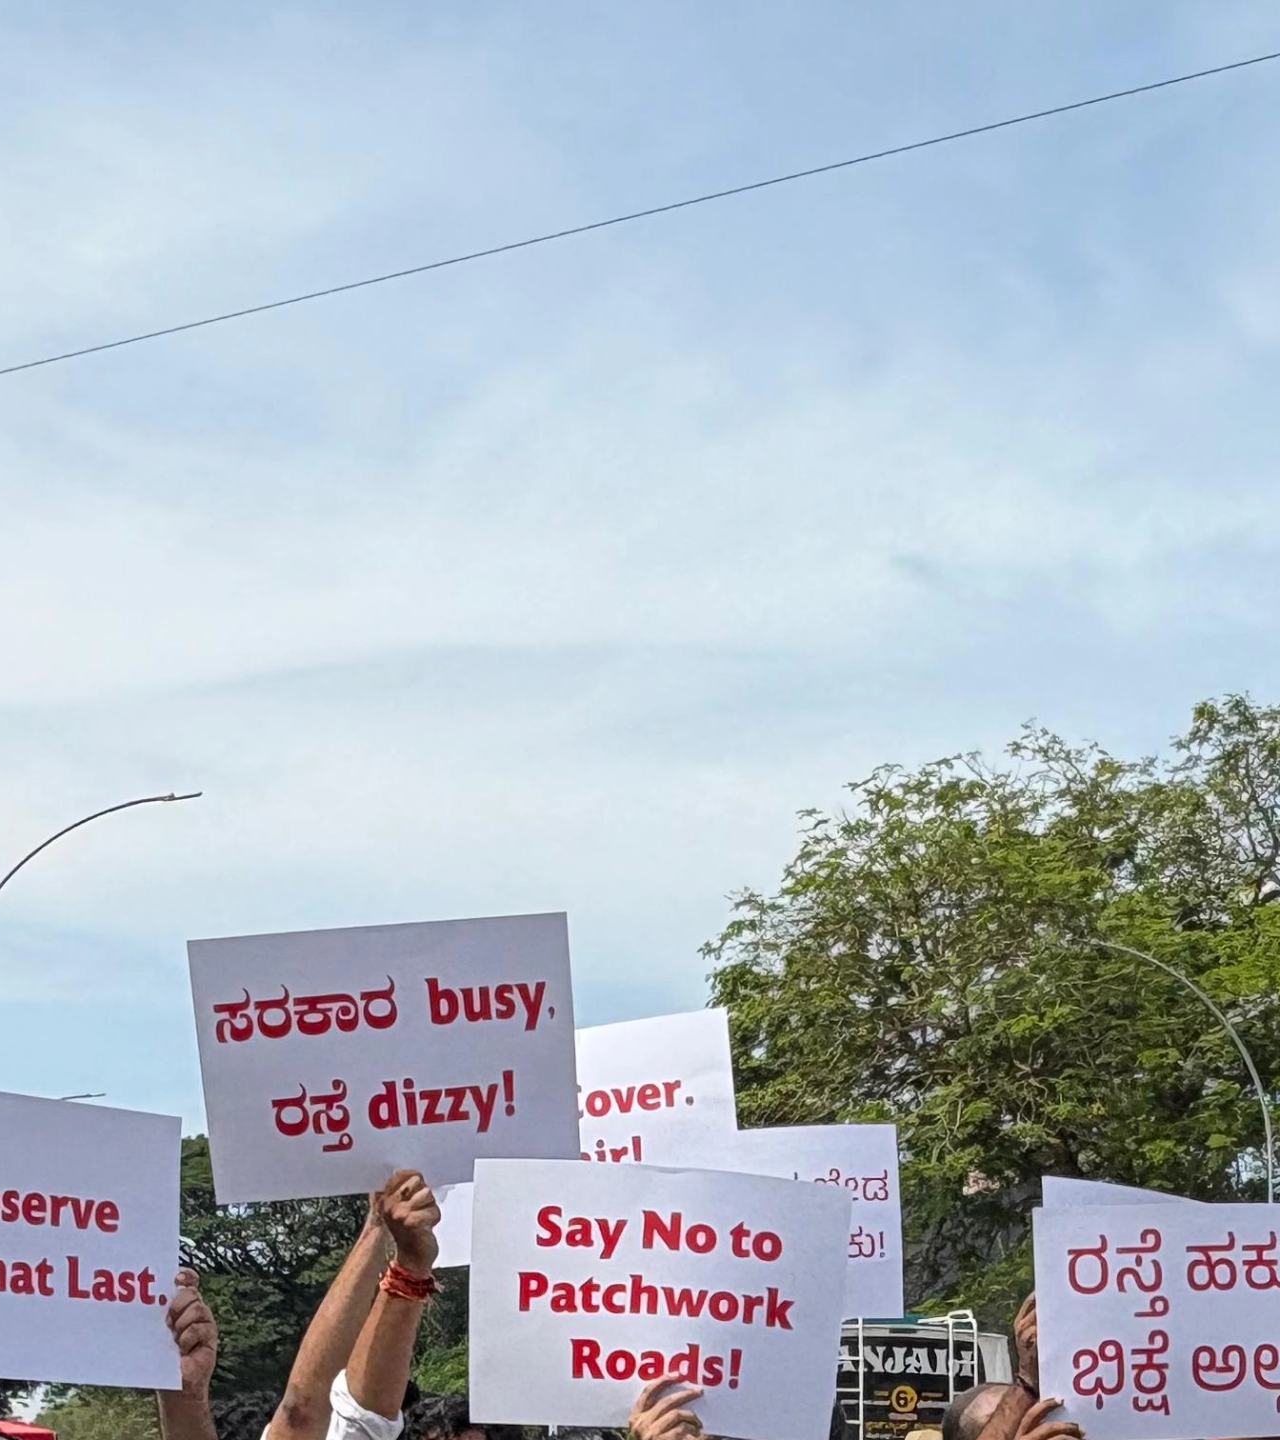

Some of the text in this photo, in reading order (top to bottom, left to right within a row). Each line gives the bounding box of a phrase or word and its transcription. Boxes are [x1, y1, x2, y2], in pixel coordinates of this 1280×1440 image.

[213, 975, 555, 1043] ಸರಕಾರ busy,
[271, 1070, 515, 1152] ರಸ್ತೆ dizzy!
[579, 1080, 694, 1118] over.
[536, 1206, 782, 1261] Say No to
[66, 1256, 168, 1306] Last.
[518, 1271, 793, 1329] Patchwork
[1068, 1229, 1169, 1317] ರಸ್ತೆ
[570, 1338, 742, 1388] Roads!
[1073, 1330, 1170, 1416] ಭಿಕ್ಷೆ
